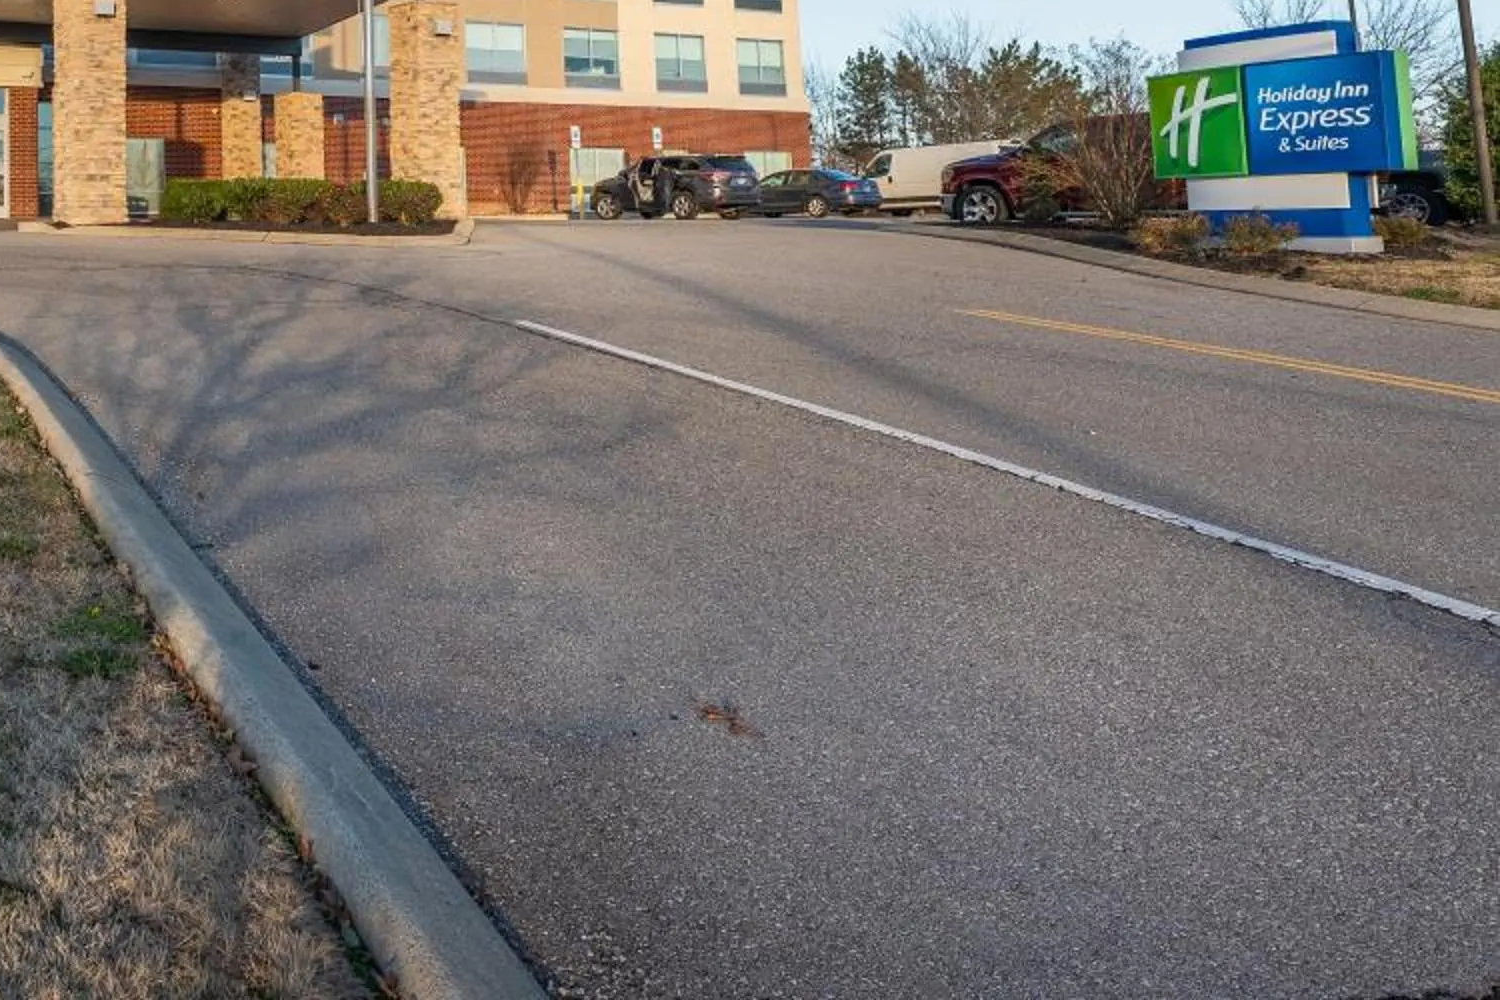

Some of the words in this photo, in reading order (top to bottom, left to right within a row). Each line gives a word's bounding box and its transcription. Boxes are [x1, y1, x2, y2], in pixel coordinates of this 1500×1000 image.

[1257, 83, 1332, 104] Holiday
[1334, 80, 1369, 99] Inn
[1260, 106, 1371, 135] Express
[1278, 137, 1291, 152] &
[1294, 136, 1349, 151] Suites
